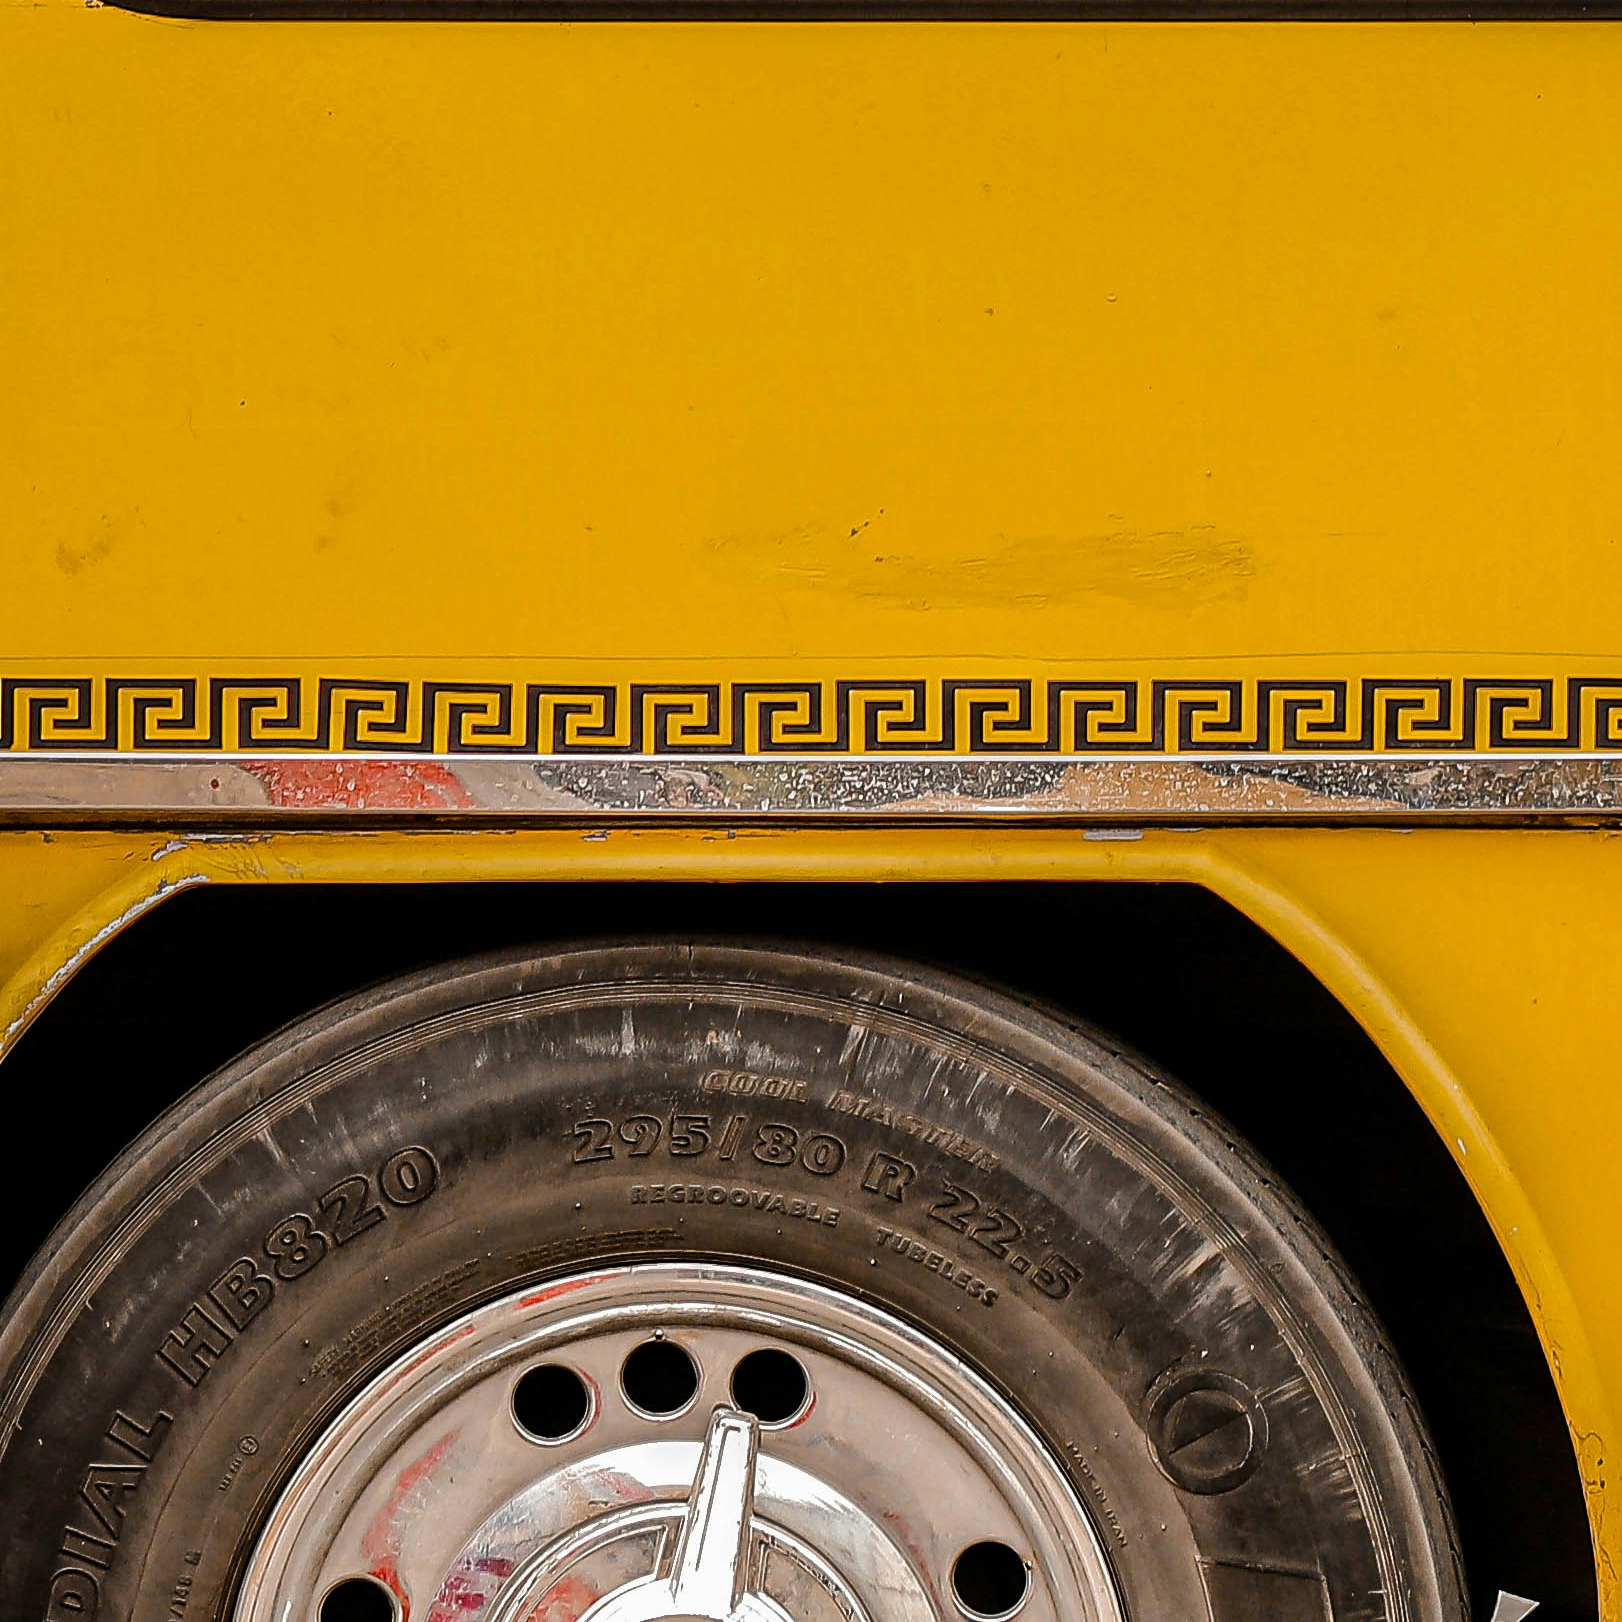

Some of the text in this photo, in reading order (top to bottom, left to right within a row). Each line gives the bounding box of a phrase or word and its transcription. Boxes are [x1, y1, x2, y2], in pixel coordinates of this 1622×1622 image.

[573, 1113, 1085, 1300] 295/80 R 22.5
[630, 1183, 1000, 1308] REGROOVABLE TUBELESS
[42, 1410, 175, 1622] DIAL
[155, 1144, 441, 1388] HB820
[1066, 1441, 1096, 1481] MADE
[1105, 1508, 1129, 1548] IRAN
